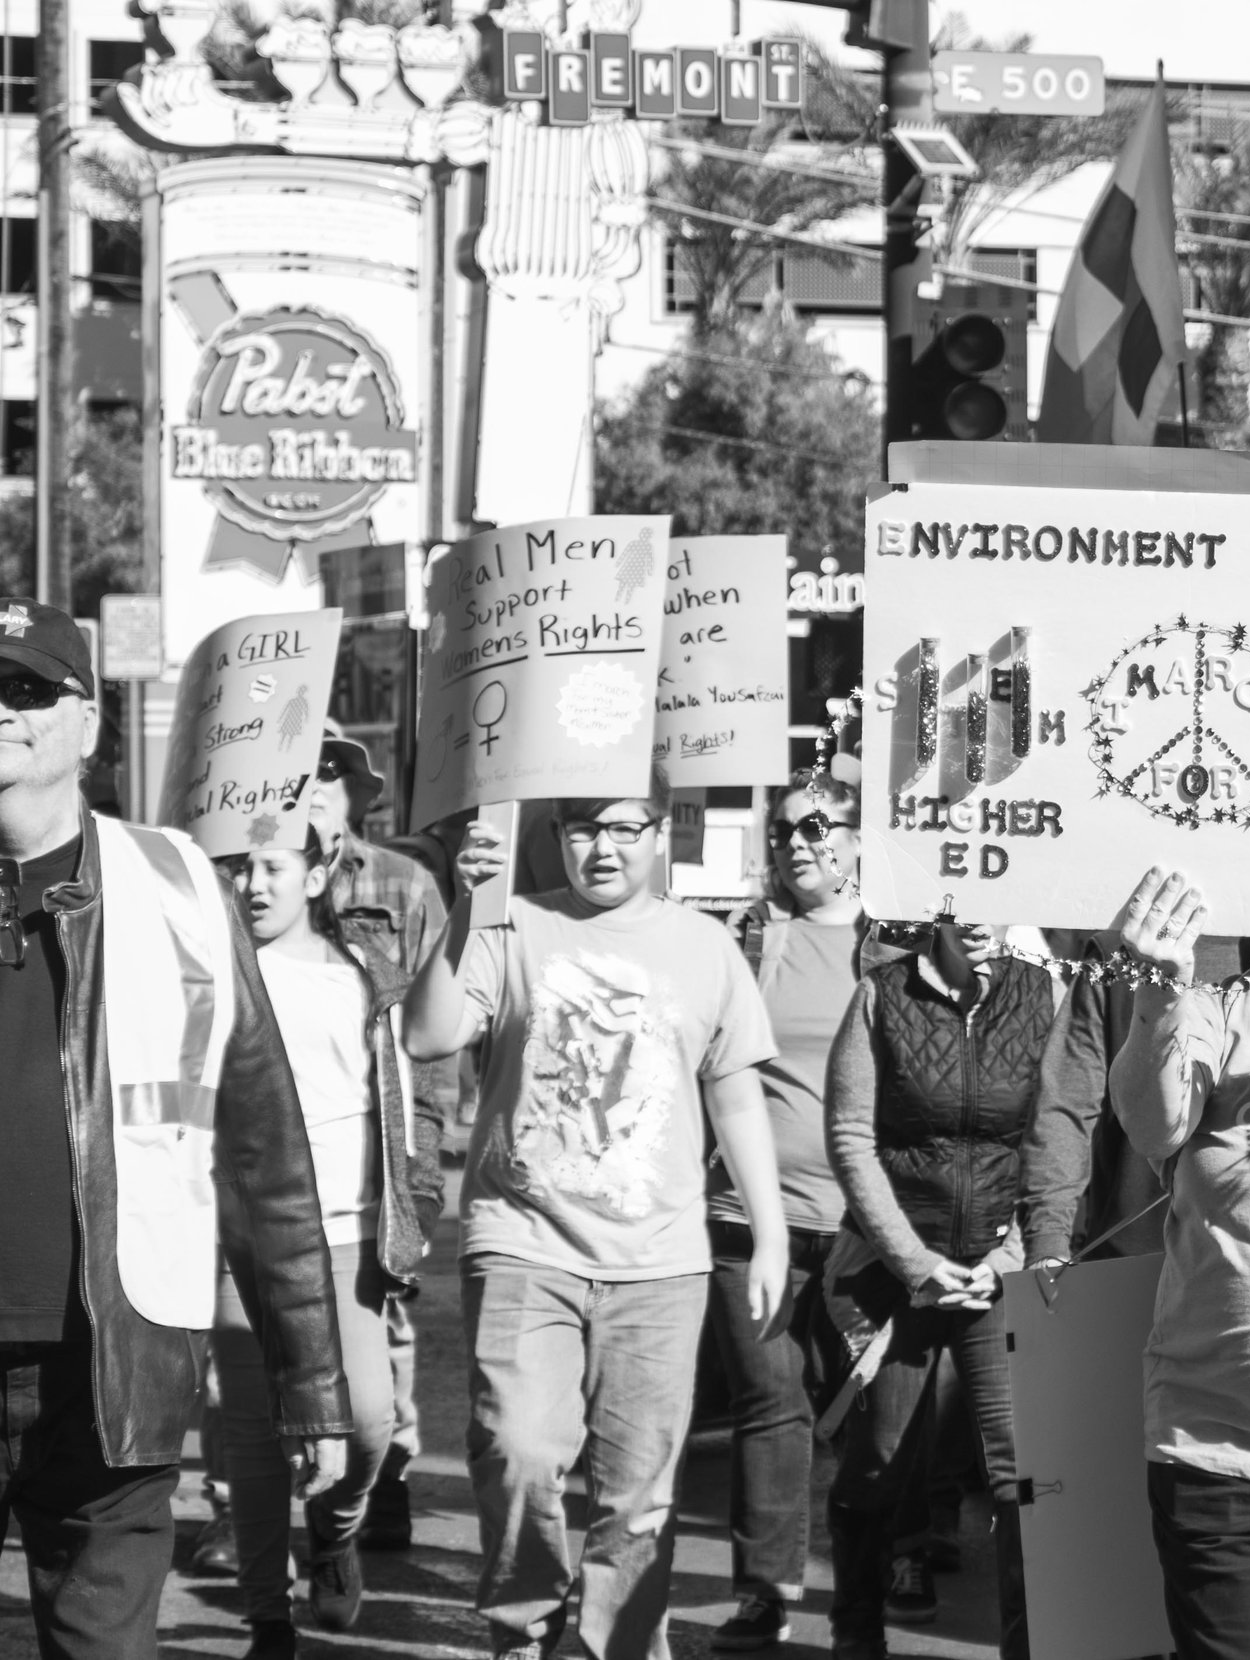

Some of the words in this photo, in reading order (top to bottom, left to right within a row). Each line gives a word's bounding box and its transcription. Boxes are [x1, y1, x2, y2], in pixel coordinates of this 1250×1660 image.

[514, 54, 796, 102] FREMONT
[1002, 66, 1091, 100] 500
[216, 333, 372, 418] Pabst
[171, 426, 267, 479] Blue
[267, 426, 414, 481] Ribbon
[448, 543, 505, 604] Real
[525, 529, 616, 572] Men
[877, 521, 1227, 569] ENVIRONMENT
[460, 579, 573, 632] Support
[663, 586, 740, 616] when
[216, 652, 230, 672] a
[237, 629, 312, 662] GIRL
[440, 629, 528, 682] Womens
[538, 613, 643, 650] Rights
[680, 624, 728, 645] are
[204, 716, 264, 750] Strong
[1149, 761, 1240, 805] FOR
[890, 794, 1064, 839] HIGHER
